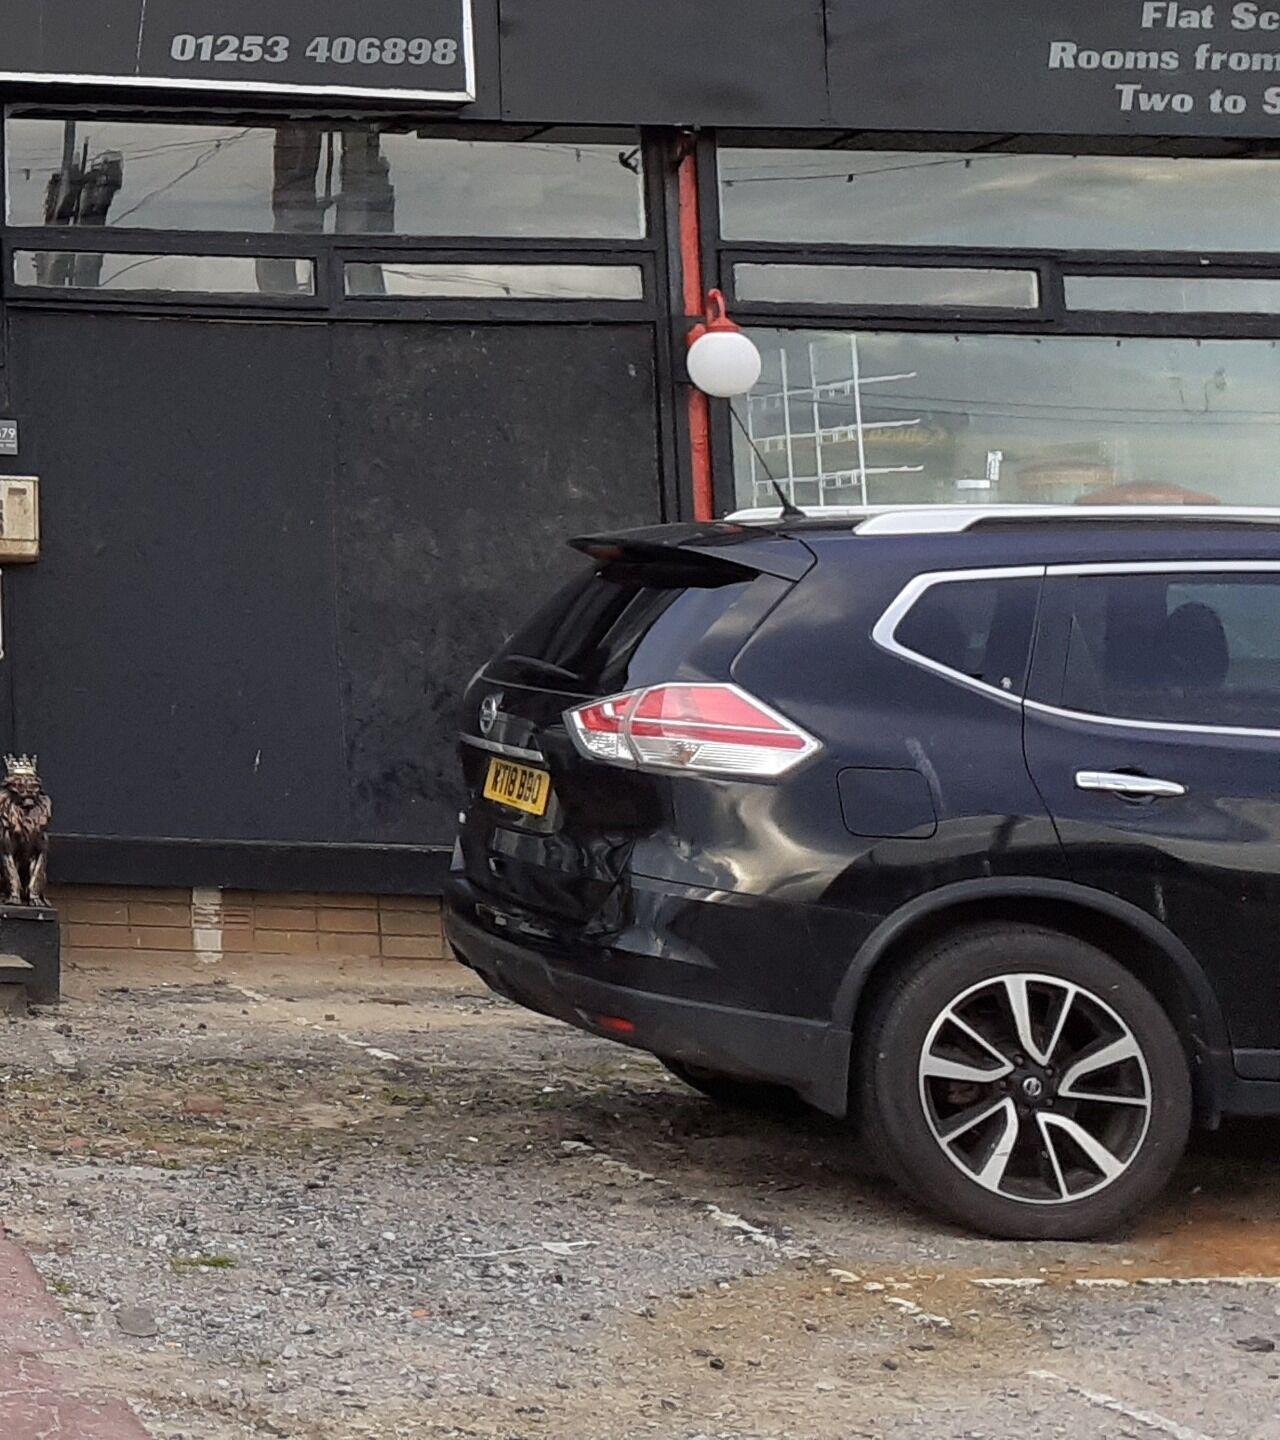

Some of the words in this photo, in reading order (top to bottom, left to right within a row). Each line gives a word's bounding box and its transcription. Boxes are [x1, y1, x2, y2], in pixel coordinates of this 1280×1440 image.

[1141, 1, 1215, 29] Flat
[170, 34, 289, 62] 01253
[305, 36, 458, 65] 406898
[1048, 41, 1180, 70] Rooms
[1194, 43, 1280, 71] from
[1115, 83, 1194, 112] Two
[1209, 89, 1247, 114] to
